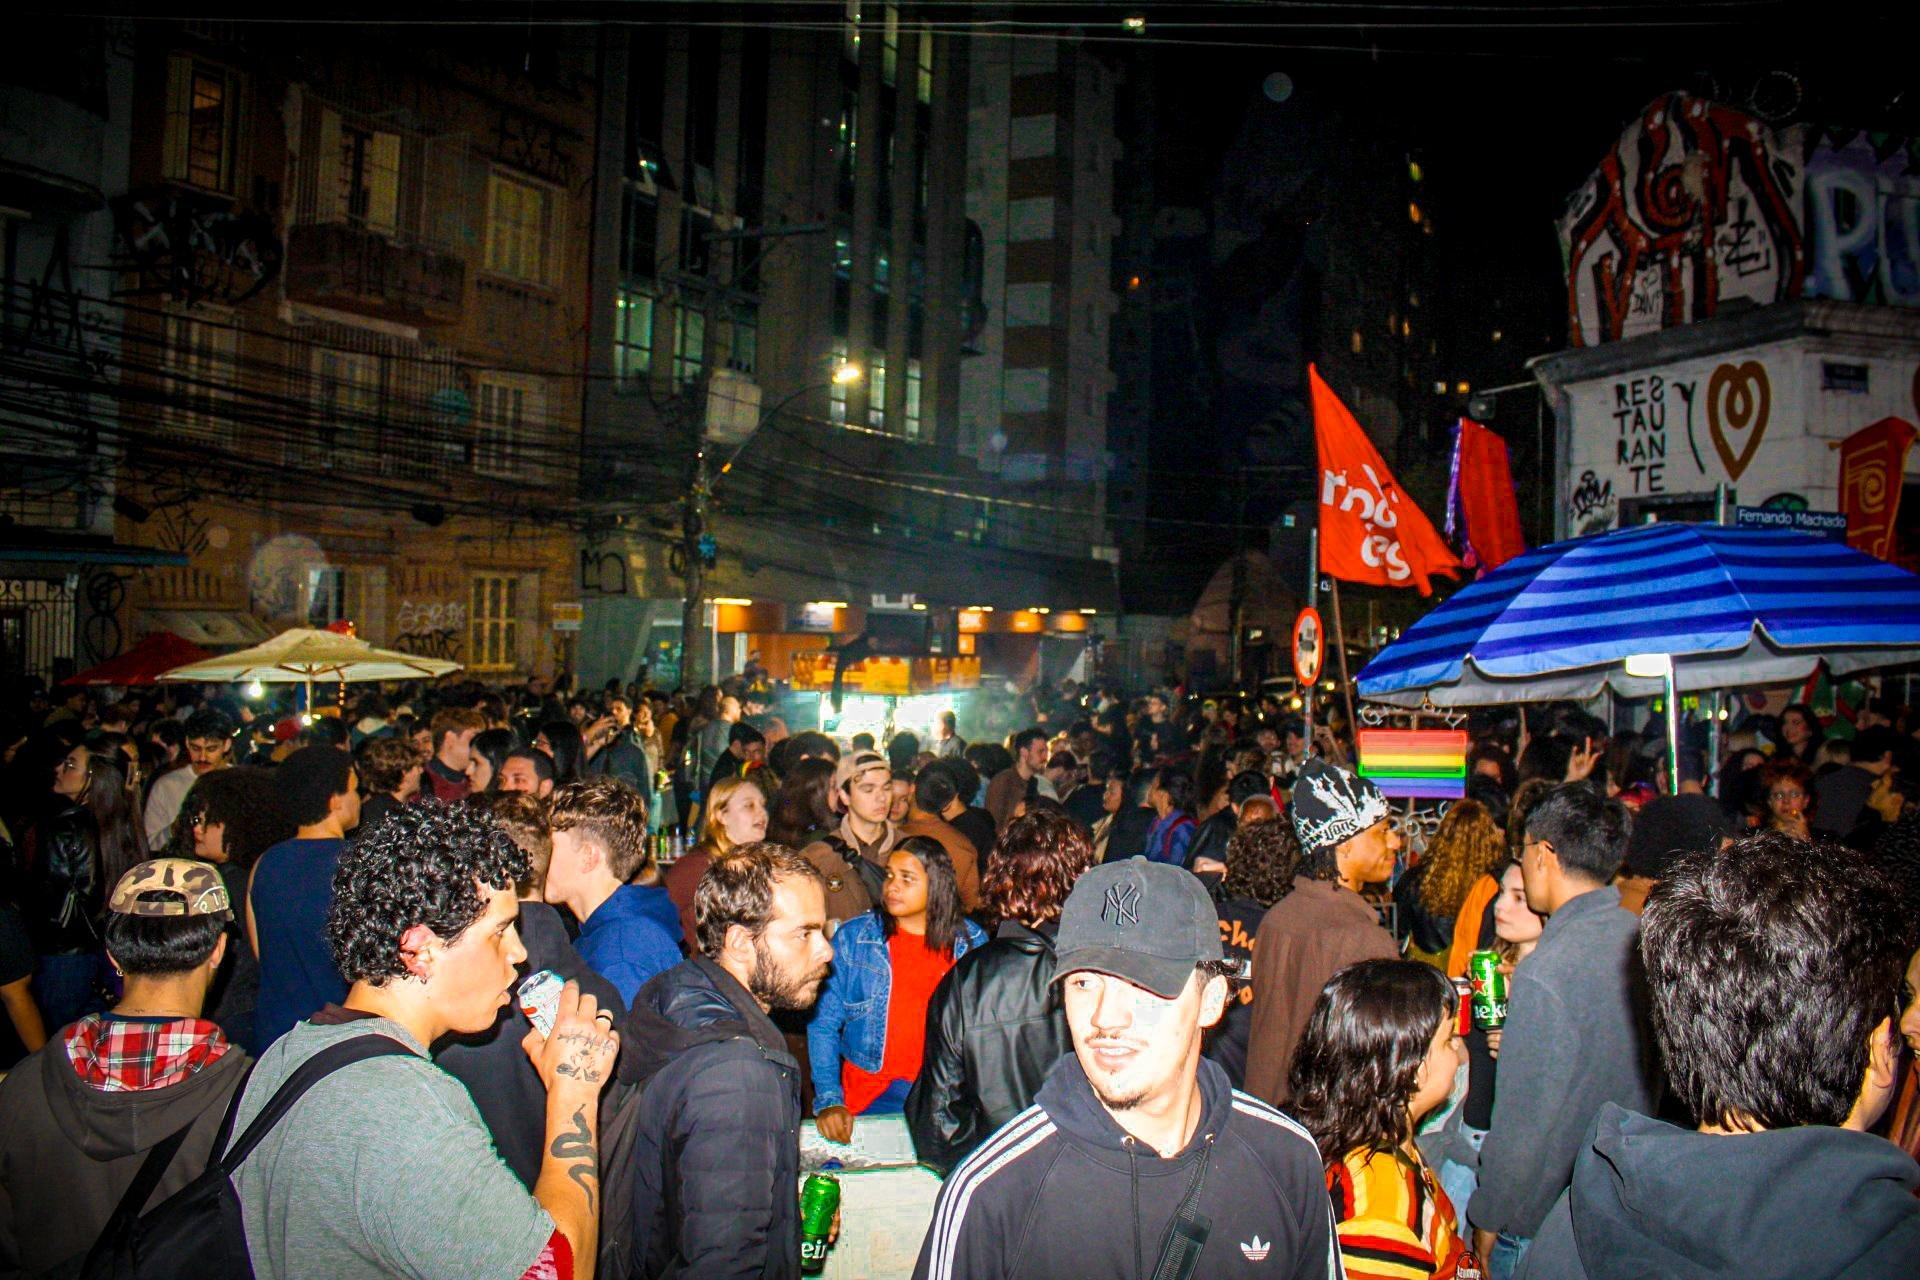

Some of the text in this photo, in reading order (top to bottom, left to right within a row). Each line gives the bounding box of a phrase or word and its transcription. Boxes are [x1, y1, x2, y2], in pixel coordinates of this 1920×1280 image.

[1613, 403, 1665, 435] TAU
[1617, 433, 1665, 465] RAN
[1630, 463, 1665, 493] TE
[1738, 508, 1847, 529] Fernando Machado
[1101, 882, 1141, 926] NY
